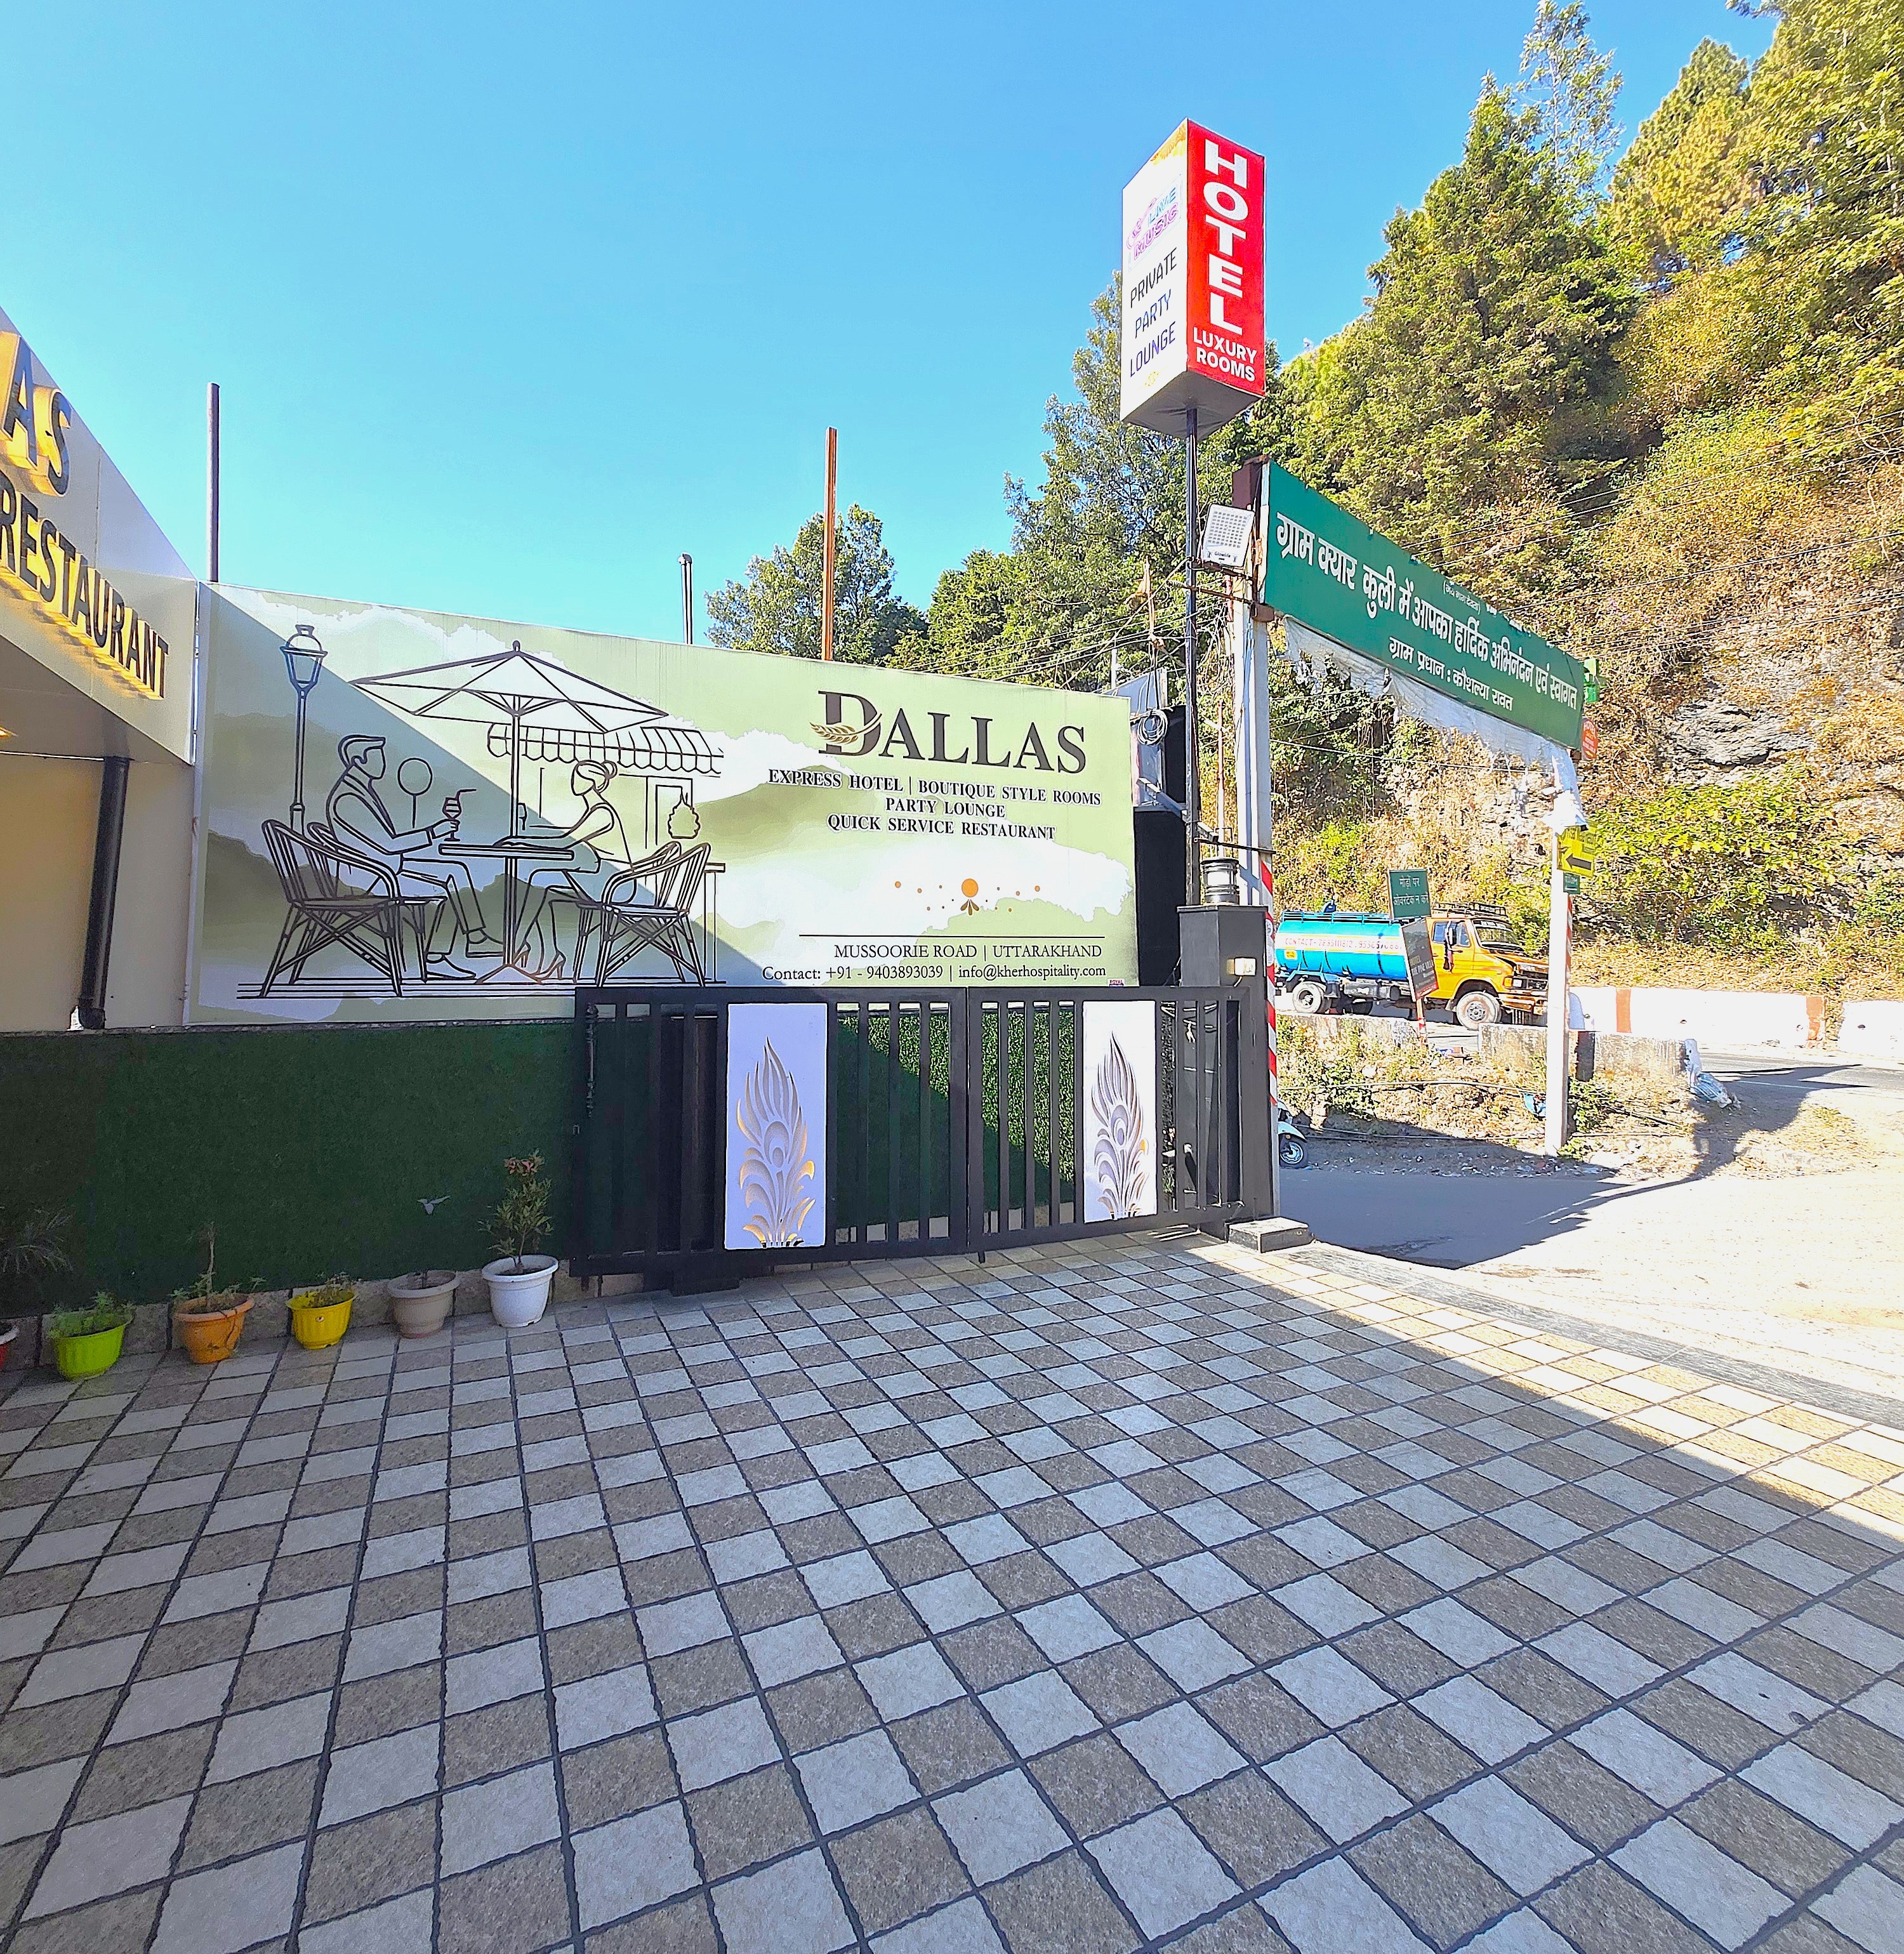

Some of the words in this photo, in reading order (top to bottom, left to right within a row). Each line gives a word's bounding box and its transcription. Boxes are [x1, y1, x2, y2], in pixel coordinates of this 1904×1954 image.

[1134, 202, 1178, 260] MUSIC
[1149, 187, 1176, 224] LIVE
[1203, 138, 1248, 336] HOTEL
[1130, 247, 1177, 308] PRIVATE
[1135, 288, 1172, 339] PARTY
[1130, 320, 1176, 378] LOUNGE
[1193, 326, 1257, 364] LUXURY
[1196, 346, 1255, 382] ROOMS
[0, 468, 169, 699] RESTAURANT
[1276, 512, 1316, 566] ग्राम
[1318, 537, 1358, 590] क्यार
[1363, 564, 1397, 619] कुली
[1399, 577, 1414, 621] में
[1412, 597, 1454, 644] आपका
[1454, 616, 1490, 662] हार्दिक
[1490, 636, 1535, 687] अभिनंदन
[1535, 663, 1550, 695] एवं
[1550, 674, 1578, 710] स्वागत
[1389, 637, 1415, 664] ग्राम
[1417, 650, 1445, 680] प्रधान
[1452, 666, 1490, 701] कौशल्या
[1491, 687, 1514, 711] रावत
[817, 690, 1087, 774] DALLAS
[768, 769, 842, 788] EXPRESS
[849, 774, 904, 792] HOTEL
[919, 780, 996, 799] BOUTIQUE
[1002, 786, 1047, 802] STYLE
[1052, 789, 1101, 805] ROOMS
[885, 797, 937, 814] PARTY
[944, 801, 1006, 818] LOUNGE
[828, 814, 881, 831] QUICK
[888, 817, 954, 835] SERVICE
[962, 822, 1055, 840] RESTAURANT
[762, 966, 821, 980] Contact:
[826, 965, 852, 979] +91
[867, 965, 943, 979] 9403893039
[958, 964, 1106, 981] info@kherhospitality.com
[834, 944, 929, 958] MUSSOORIE
[933, 945, 977, 958] ROAD
[992, 945, 1102, 958] UTTARAKHAND
